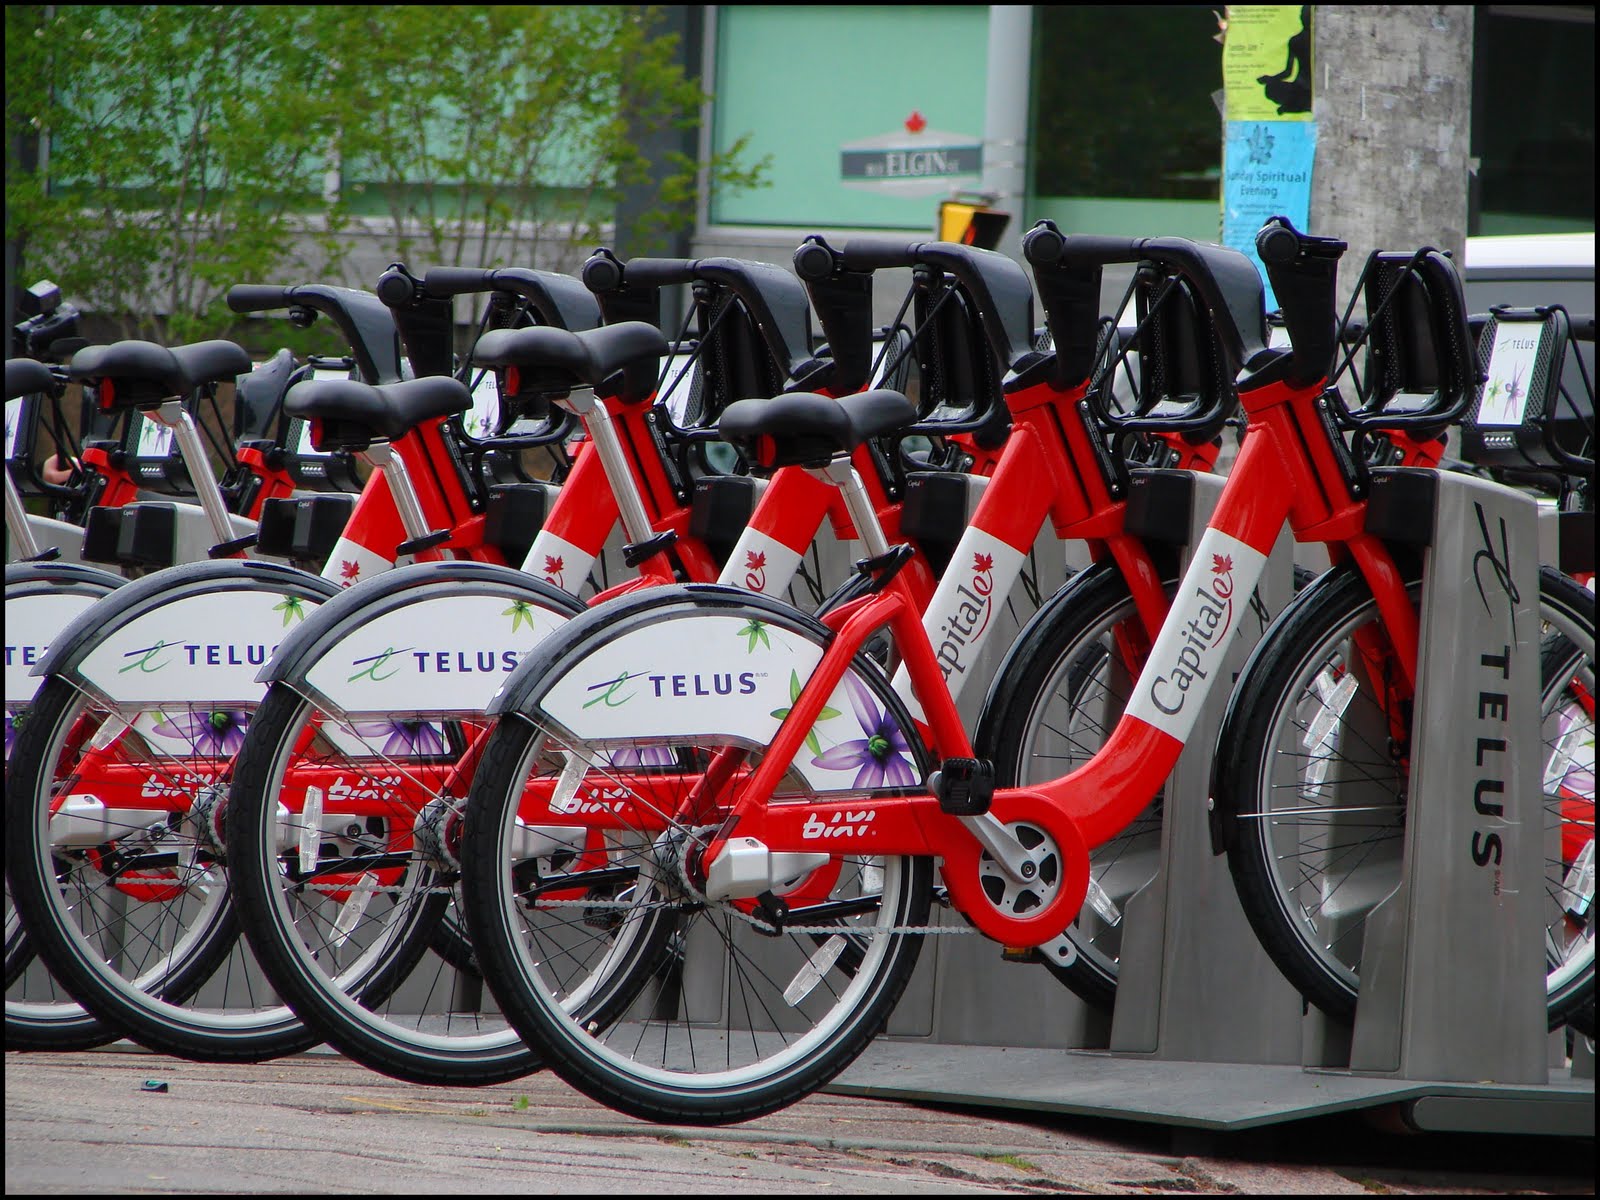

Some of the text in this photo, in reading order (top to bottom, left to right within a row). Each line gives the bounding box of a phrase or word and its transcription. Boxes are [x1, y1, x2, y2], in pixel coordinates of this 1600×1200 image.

[886, 150, 948, 177] ELGIN
[1256, 171, 1307, 184] Spiritual
[1240, 185, 1278, 200] Evening
[1512, 338, 1536, 350] TELUS
[670, 369, 691, 378] TES
[910, 570, 994, 702] apitale
[1150, 571, 1235, 717] Capitale
[183, 645, 279, 666] TELU
[413, 651, 519, 673] TELUS
[648, 672, 757, 698] TELUS
[1471, 644, 1510, 867] TELUS
[802, 810, 876, 839] bixi
